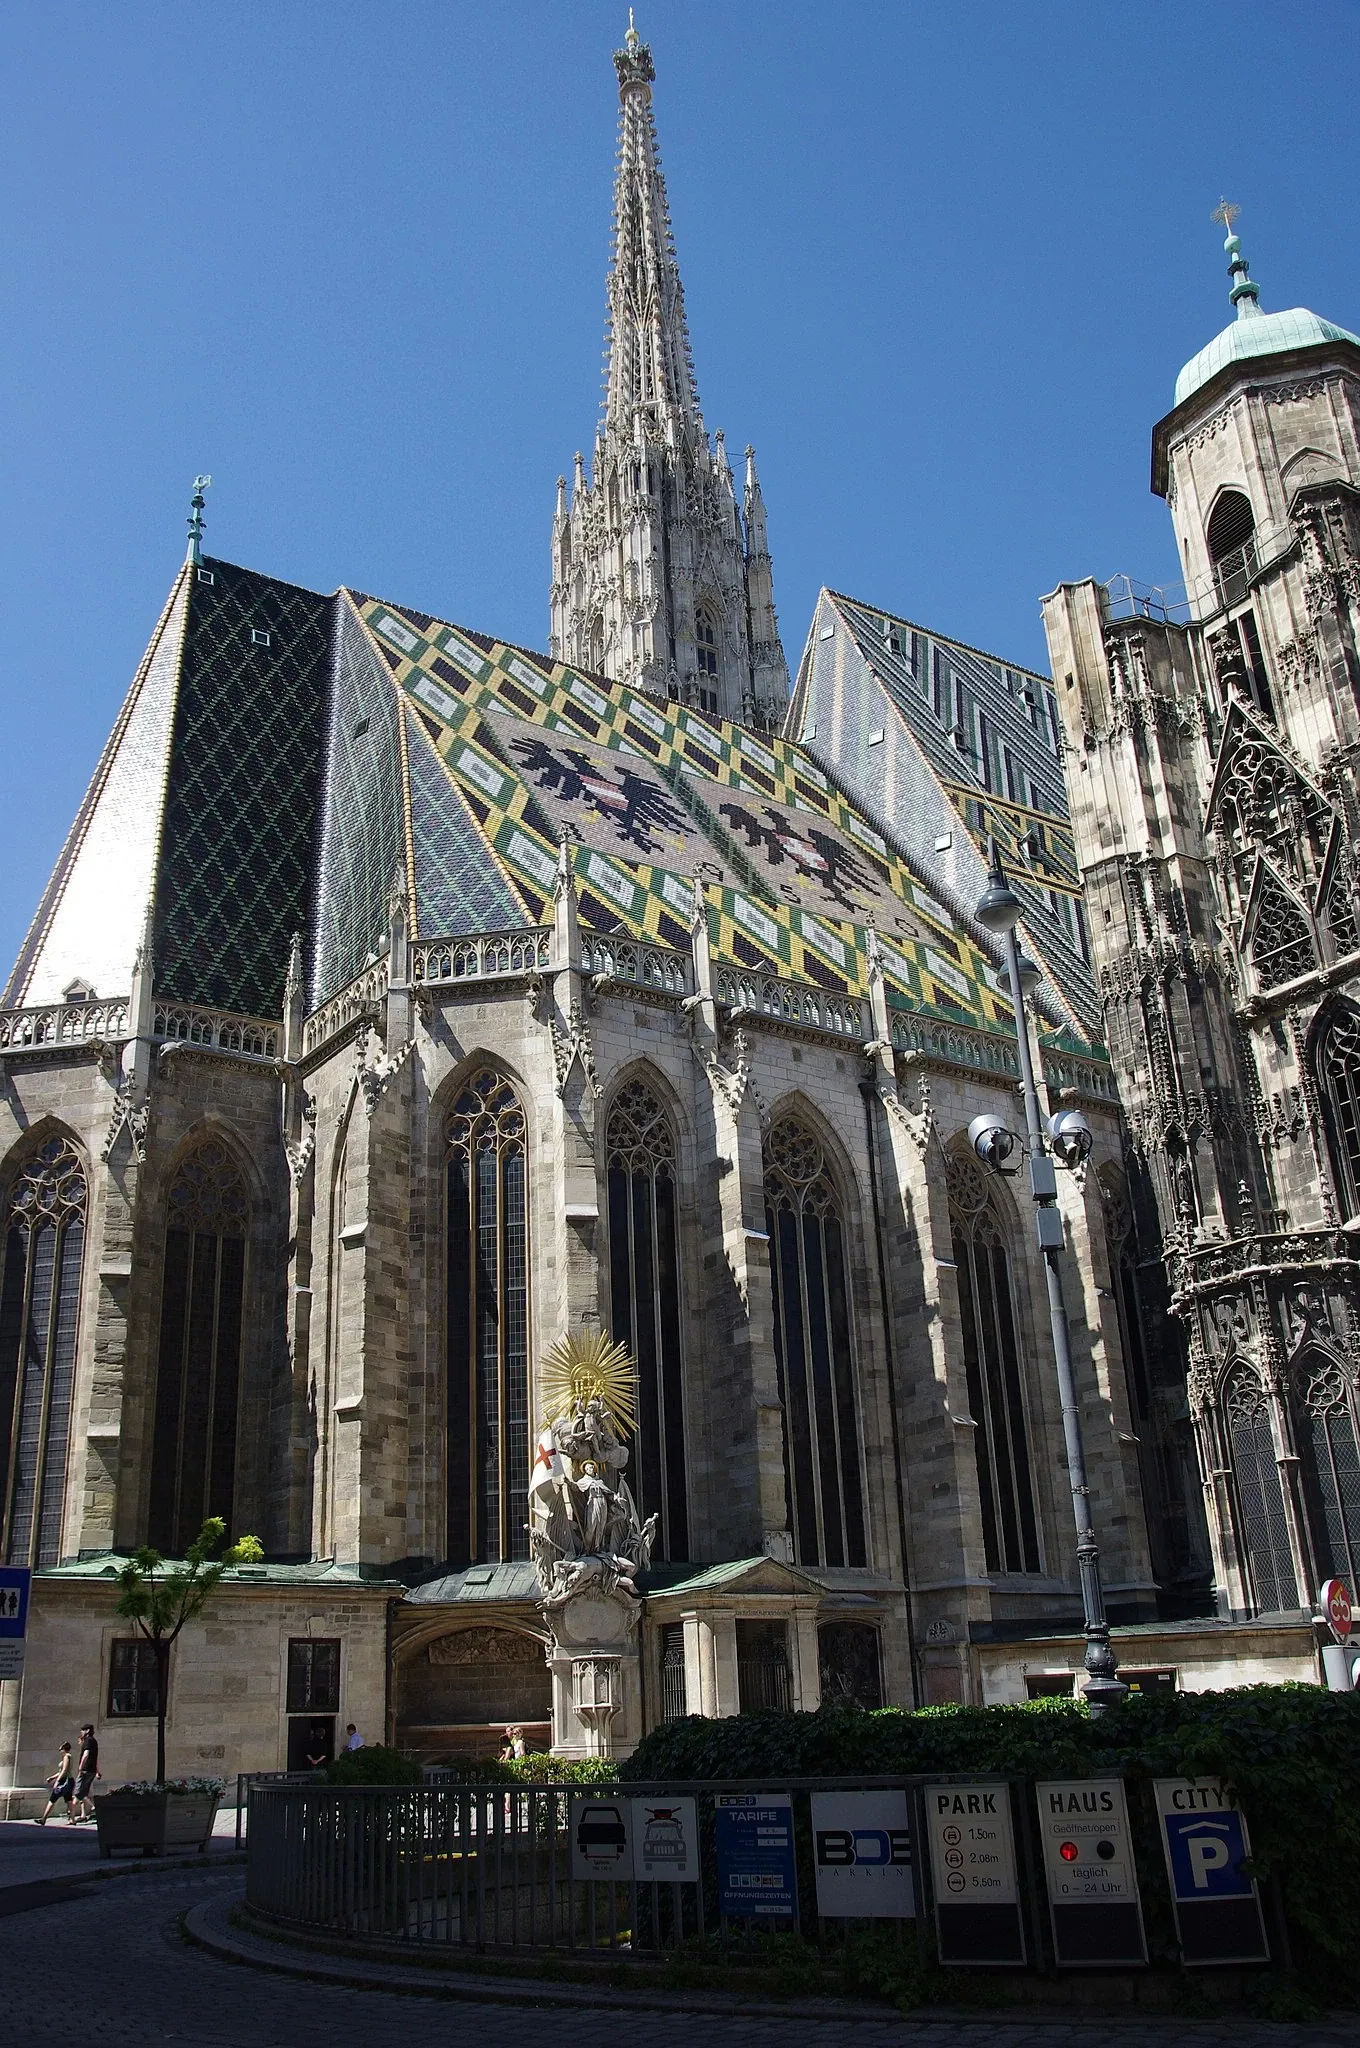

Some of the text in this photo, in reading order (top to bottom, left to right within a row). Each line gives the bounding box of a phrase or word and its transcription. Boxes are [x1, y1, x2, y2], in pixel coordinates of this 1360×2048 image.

[937, 1793, 997, 1815] PARK
[1049, 1791, 1113, 1813] HAUS
[1172, 1787, 1225, 1810] CITY
[729, 1811, 777, 1821] TARIFE
[1053, 1823, 1117, 1834] Geöffnet/open
[1187, 1837, 1229, 1888] P
[1072, 1867, 1109, 1880] täglich
[1061, 1883, 1069, 1894] 0
[1084, 1883, 1097, 1893] 24
[1101, 1882, 1122, 1893] Uhr
[724, 1890, 792, 1900] ÖFFNUNGSZEITEN
